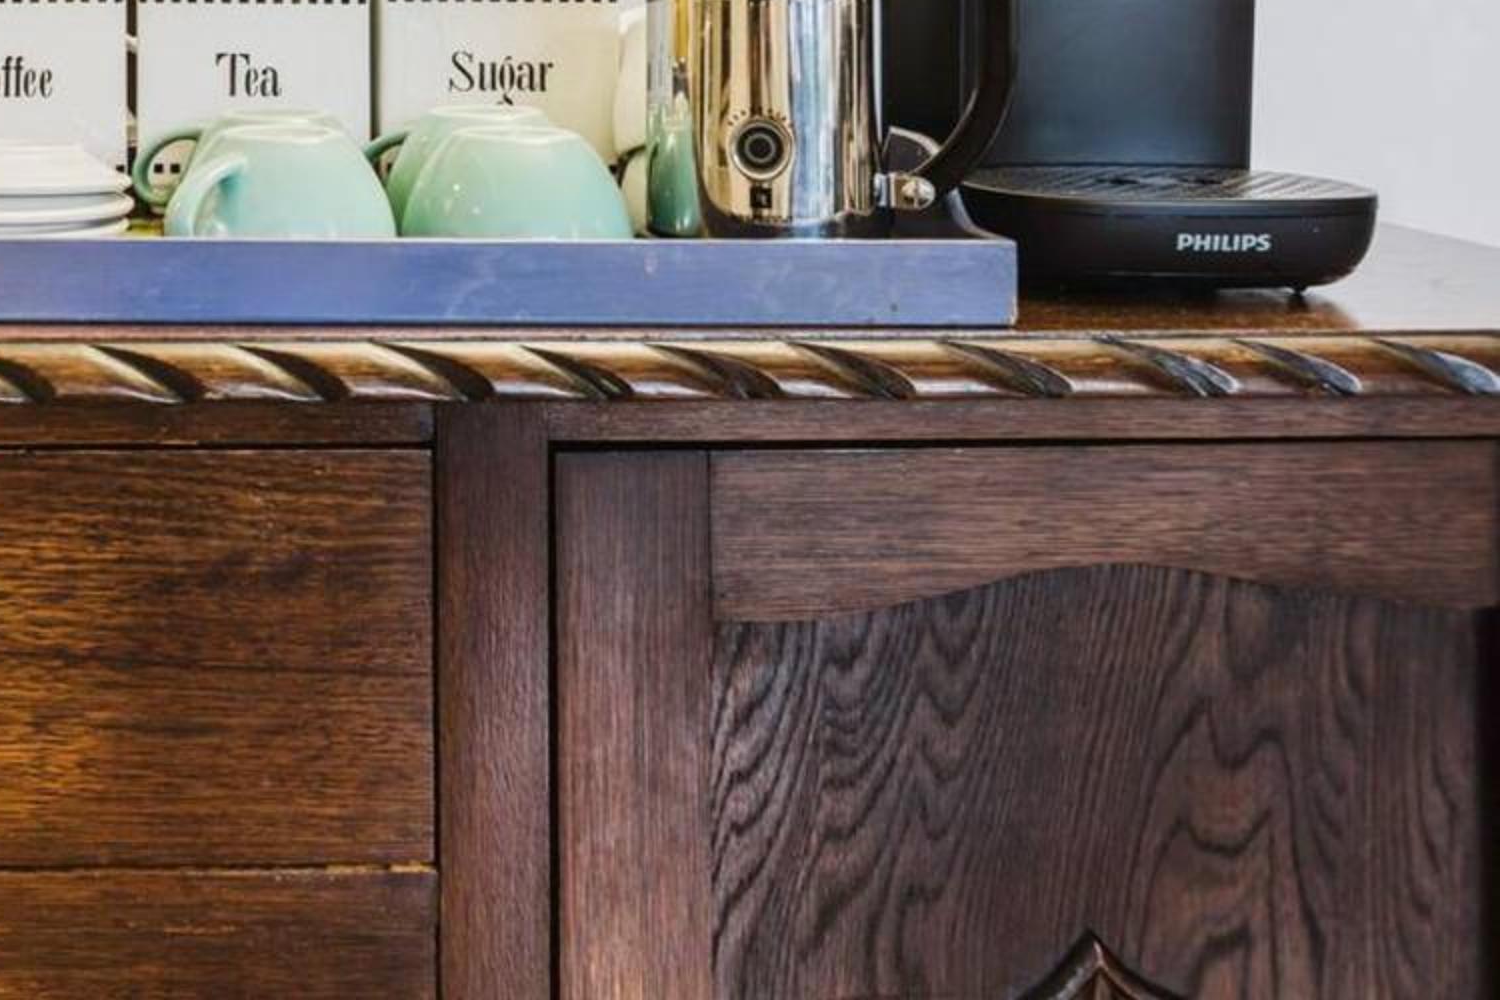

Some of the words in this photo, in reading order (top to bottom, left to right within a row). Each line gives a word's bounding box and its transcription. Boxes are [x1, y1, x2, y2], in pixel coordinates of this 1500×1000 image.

[215, 52, 281, 97] Tea
[448, 50, 554, 106] Sugar
[1176, 233, 1271, 251] PHILIPS
